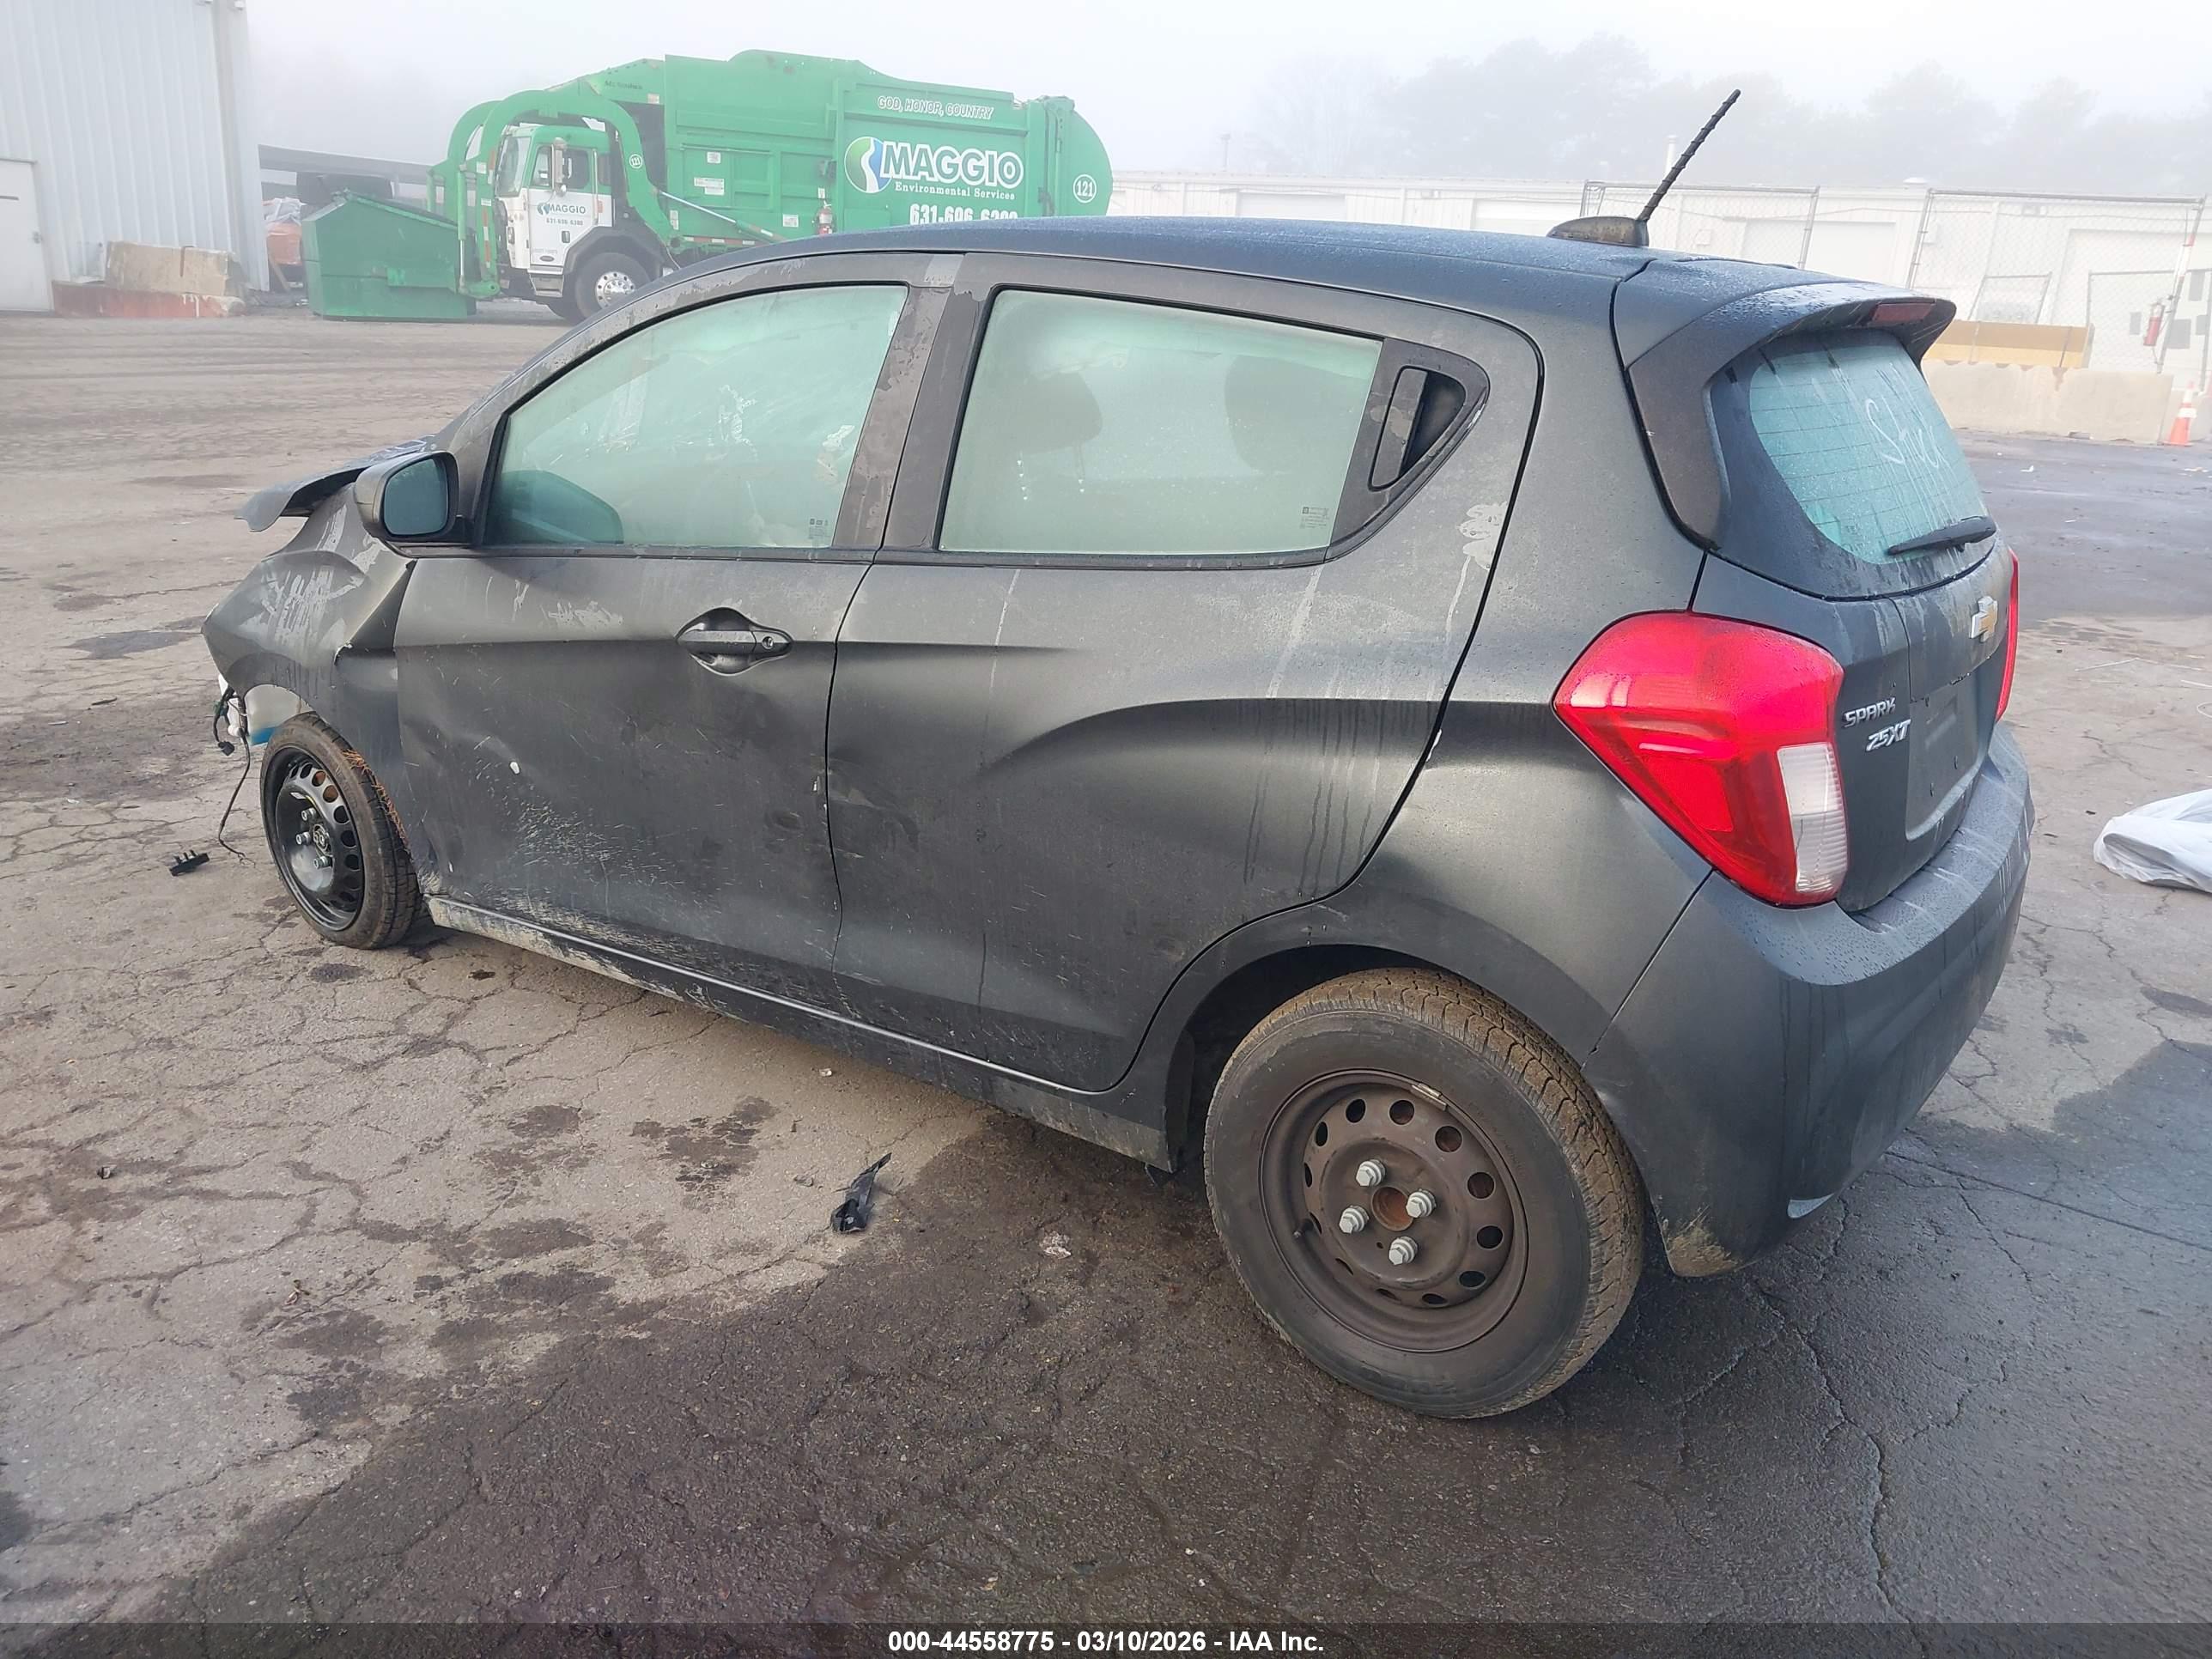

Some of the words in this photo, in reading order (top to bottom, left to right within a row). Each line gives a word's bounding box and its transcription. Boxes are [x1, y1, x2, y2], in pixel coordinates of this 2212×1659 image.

[946, 103, 994, 120] COUNTRY
[880, 141, 1024, 189] MAGGIO
[895, 181, 970, 197] Environmental
[974, 188, 1015, 200] Services
[1076, 180, 1093, 198] 121
[548, 203, 586, 215] MAGGIO
[1844, 697, 1896, 727] SPARK
